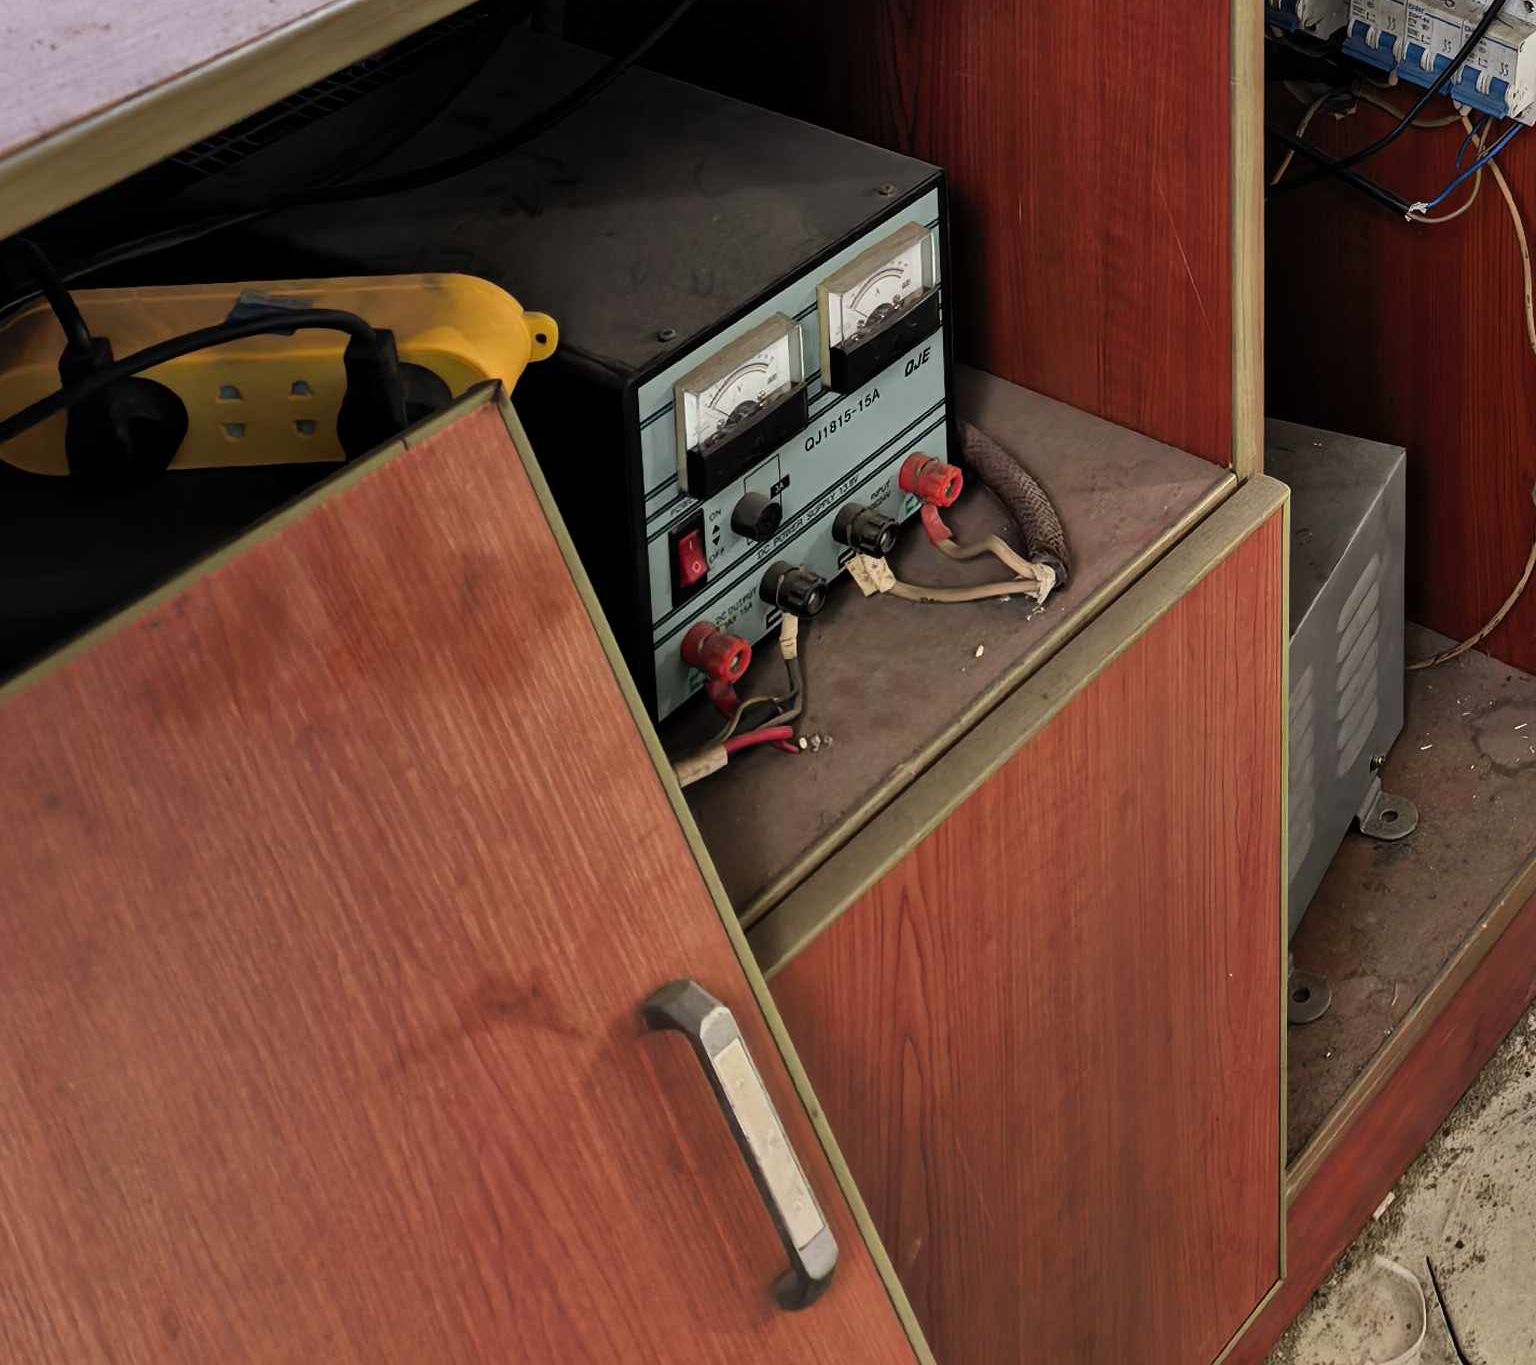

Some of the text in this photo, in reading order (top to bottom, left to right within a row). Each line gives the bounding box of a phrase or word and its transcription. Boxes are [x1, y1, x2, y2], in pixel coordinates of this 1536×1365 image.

[904, 346, 931, 377] QJE
[805, 388, 880, 452] QJ1815-15A
[708, 508, 722, 522] ON
[756, 543, 771, 560] DC
[773, 517, 803, 547] POWER
[805, 492, 836, 522] SUPPLY
[709, 547, 725, 564] OFF
[727, 587, 757, 615] OUTPUT
